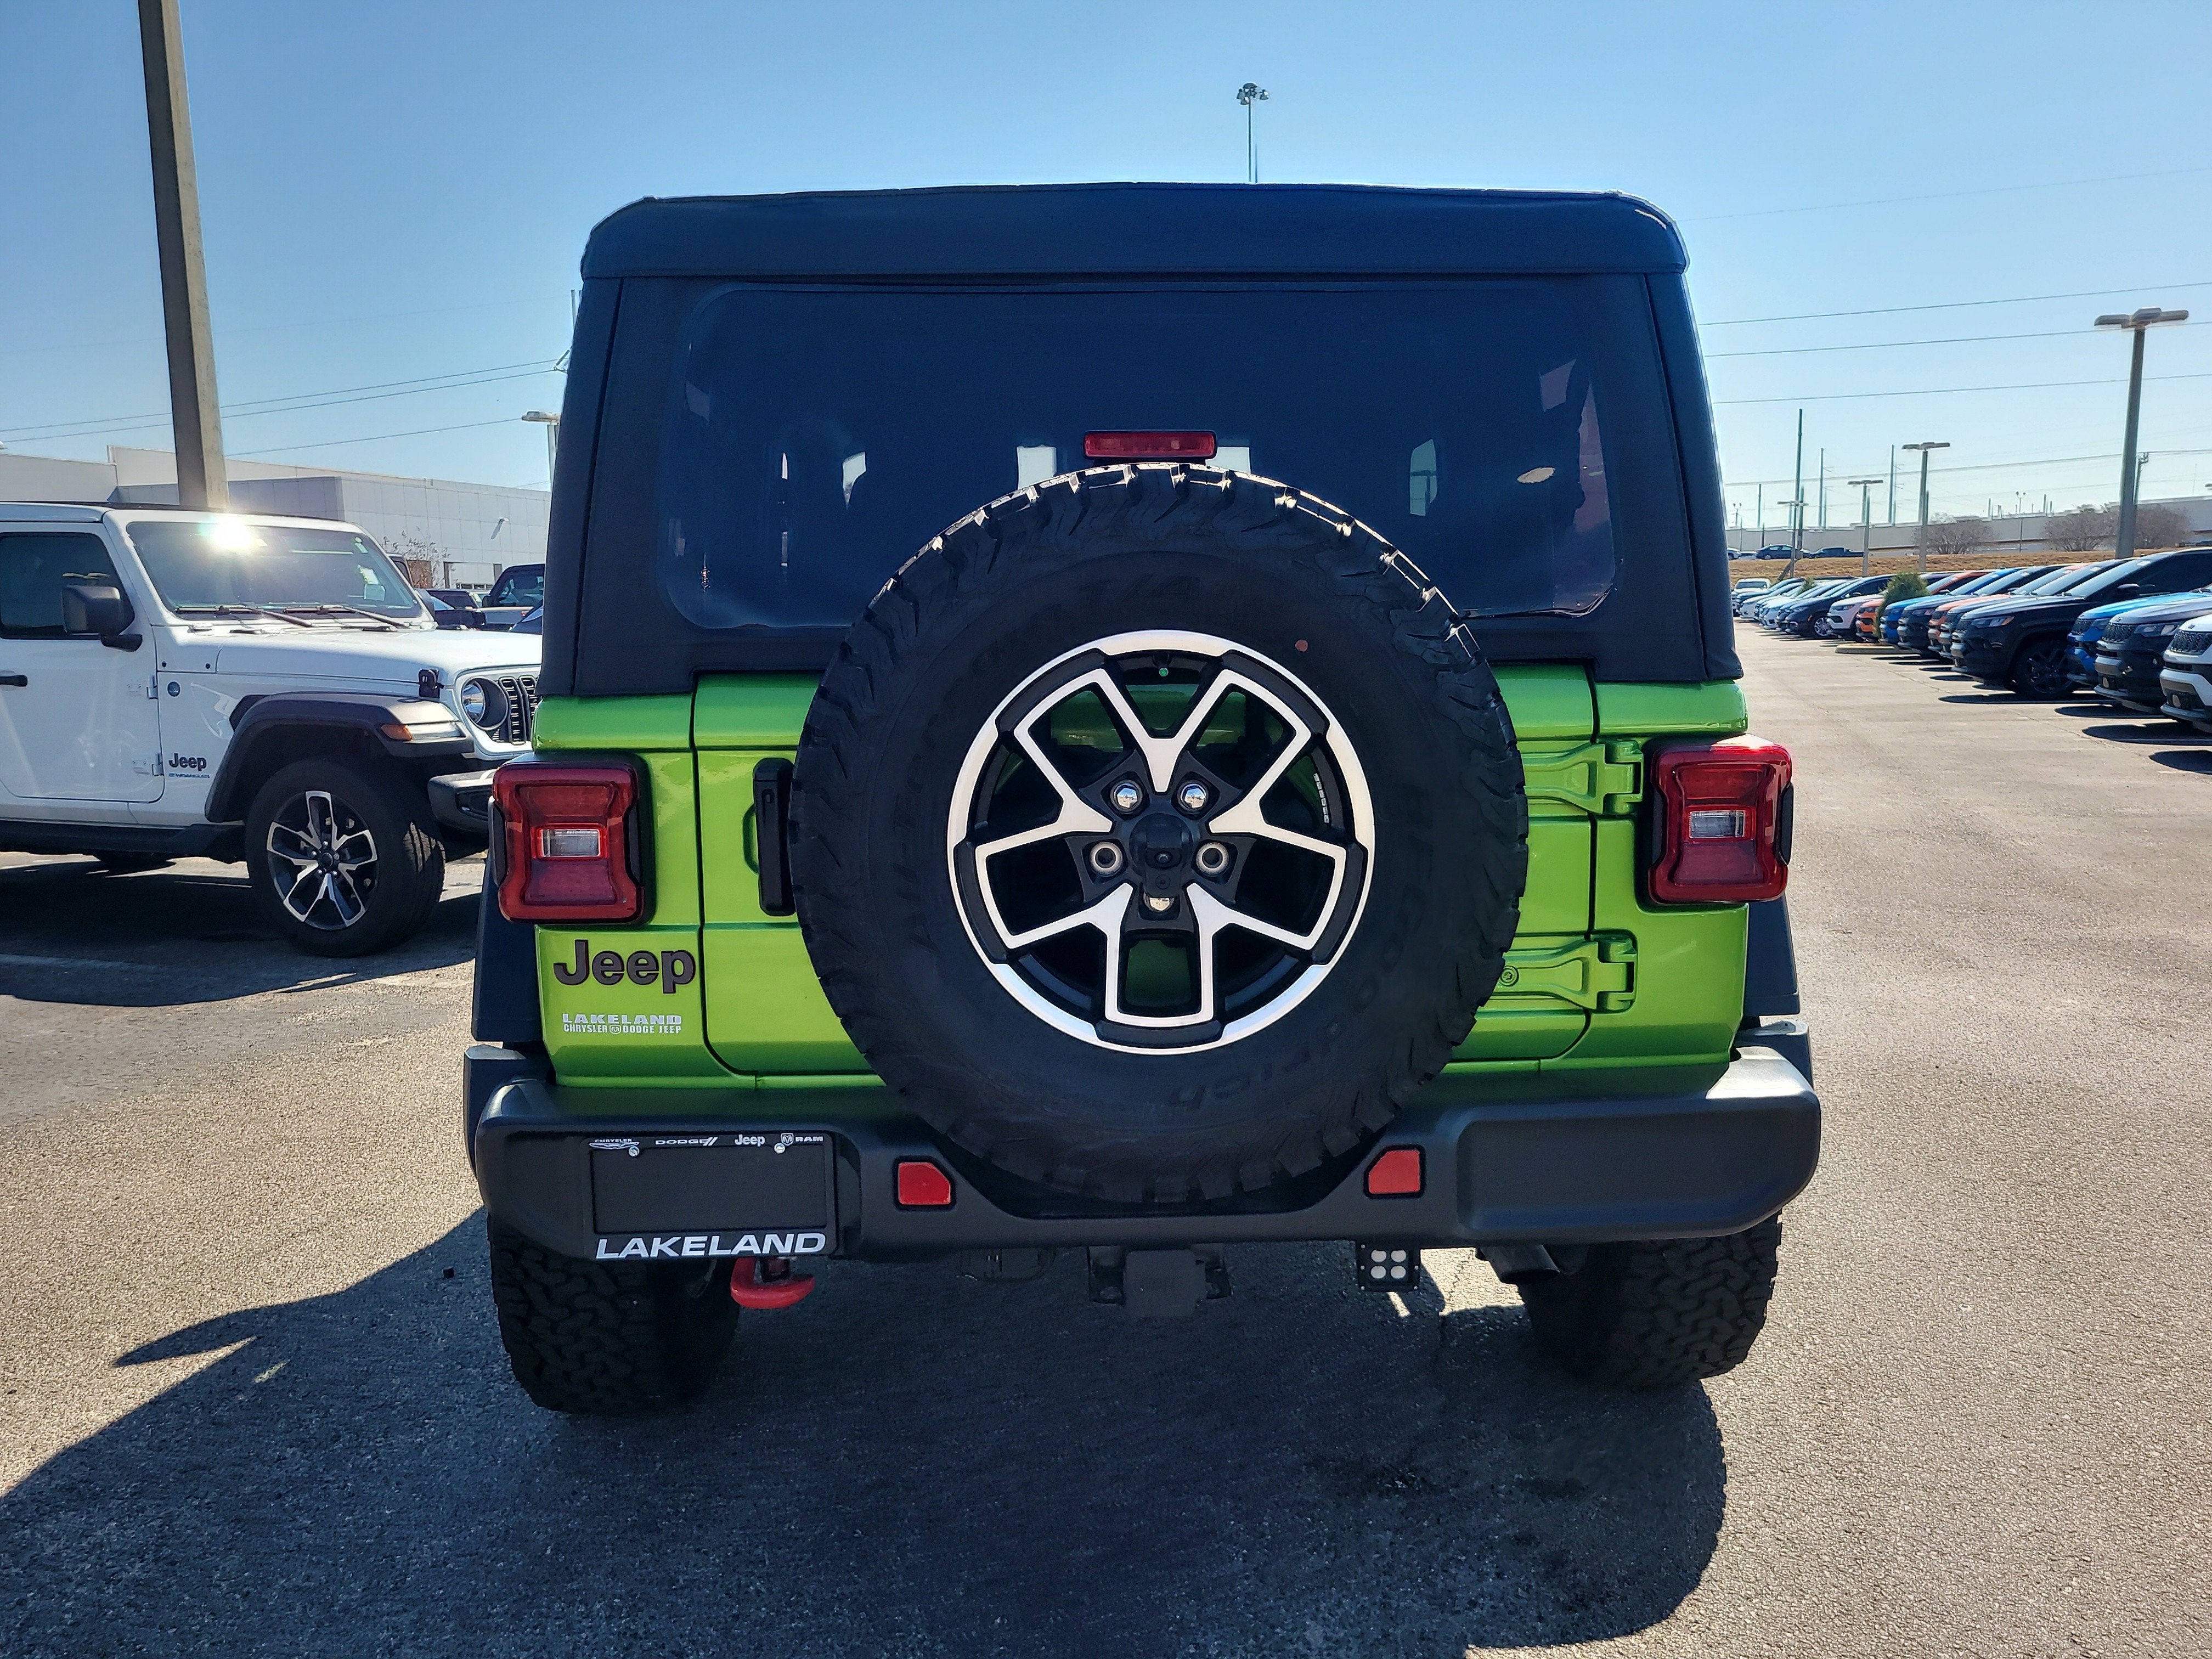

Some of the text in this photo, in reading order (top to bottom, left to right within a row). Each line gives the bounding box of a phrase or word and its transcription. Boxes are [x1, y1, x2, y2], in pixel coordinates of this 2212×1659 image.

[168, 752, 207, 771] Jeep
[553, 939, 696, 994] Jeep
[562, 1013, 682, 1024] LAKELAND
[564, 1024, 608, 1032] CHRYSLER
[735, 1135, 765, 1147] Jeep
[596, 1233, 826, 1259] LAKELAND
